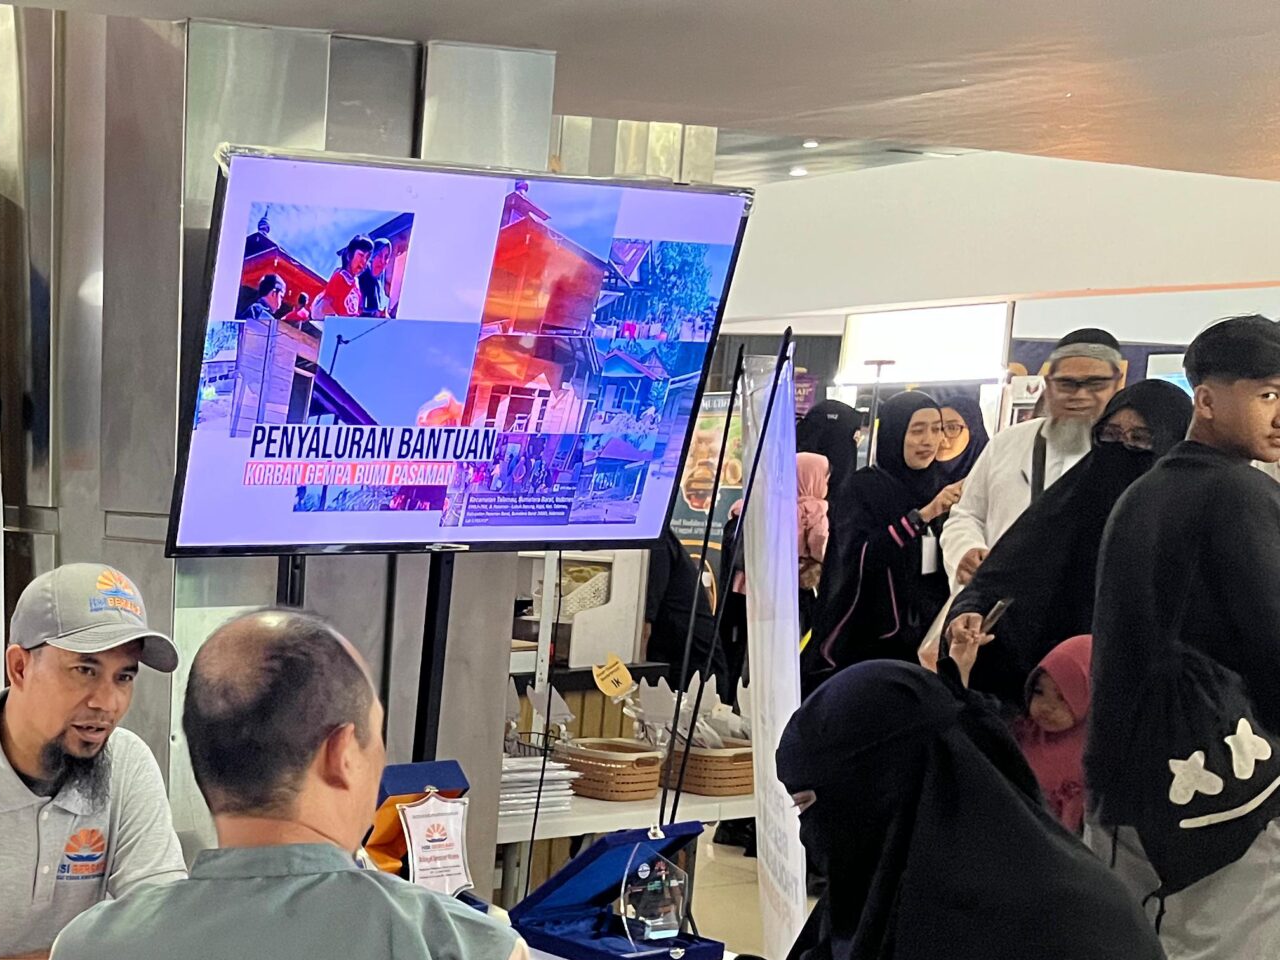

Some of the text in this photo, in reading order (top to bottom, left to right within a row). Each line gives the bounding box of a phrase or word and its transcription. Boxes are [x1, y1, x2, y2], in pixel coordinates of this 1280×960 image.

[250, 425, 496, 460] PENYALURAN BANTUAN
[245, 462, 454, 486] KORBAN GEMPA BUMI PASAMAN
